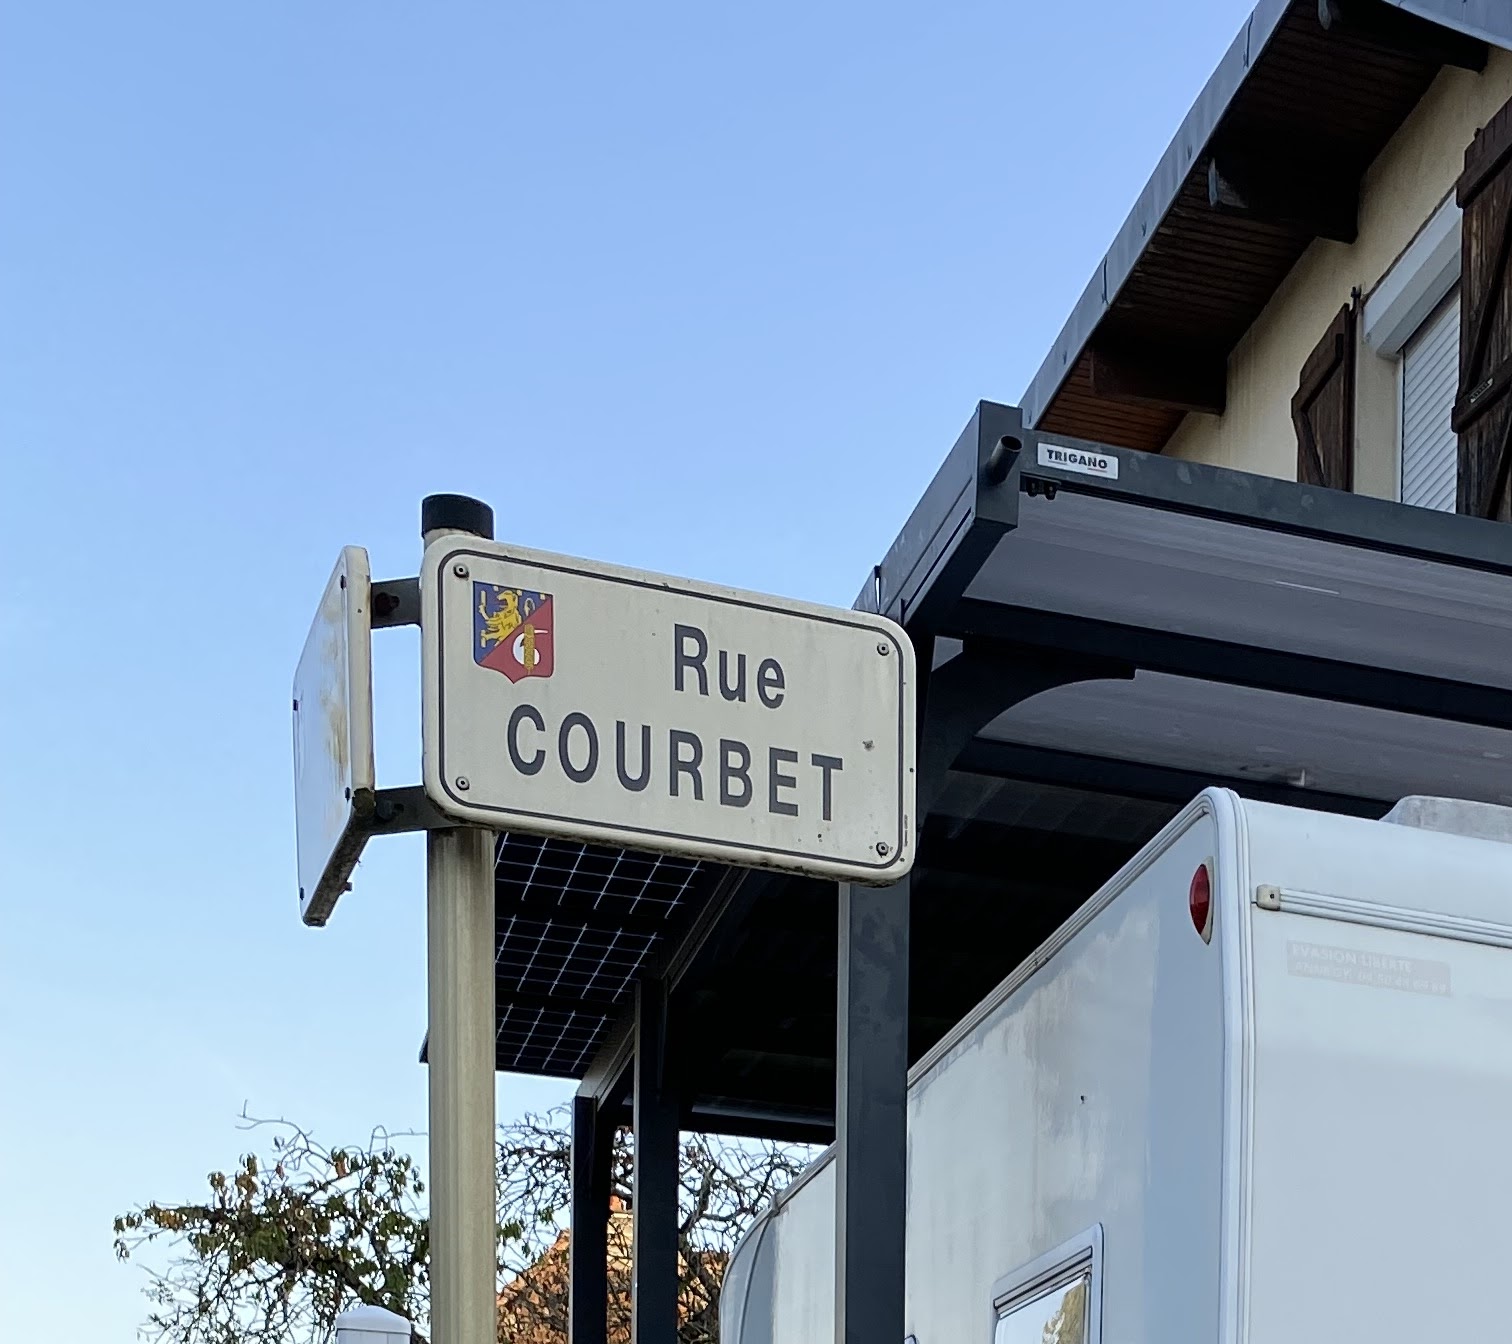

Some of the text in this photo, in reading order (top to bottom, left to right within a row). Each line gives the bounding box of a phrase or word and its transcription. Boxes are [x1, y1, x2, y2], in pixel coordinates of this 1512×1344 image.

[1046, 449, 1108, 469] TRIGANO
[674, 623, 786, 709] Rue
[507, 703, 843, 821] COURBET
